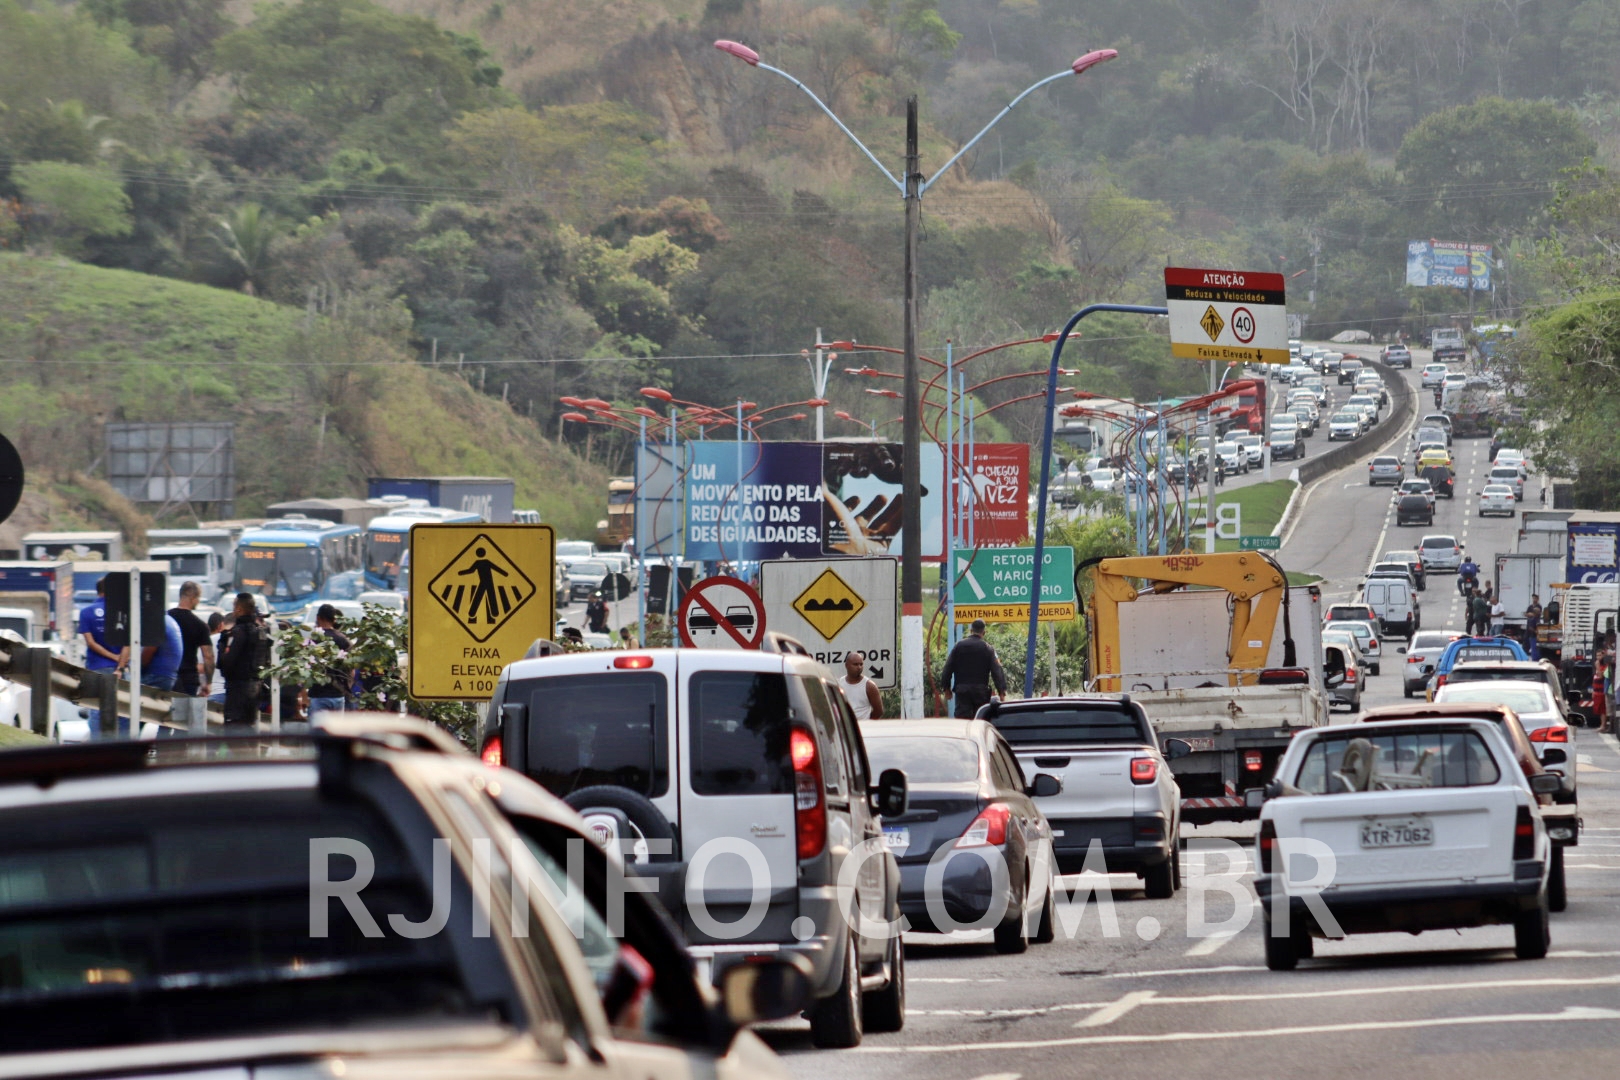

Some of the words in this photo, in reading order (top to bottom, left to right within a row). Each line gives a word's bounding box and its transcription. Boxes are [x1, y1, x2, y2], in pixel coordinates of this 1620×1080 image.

[1203, 273, 1245, 287] ATENÇÃO
[1185, 289, 1213, 299] Reduza
[1223, 292, 1265, 302] Velocidade
[1235, 316, 1251, 332] 40
[1198, 348, 1220, 357] Faixa
[1223, 350, 1252, 359] Elevada
[691, 464, 716, 480] UM
[985, 465, 1019, 477] CHEGOU
[996, 476, 1002, 486] A
[691, 485, 782, 501] MOVIMENTO
[786, 485, 825, 502] PELA
[987, 485, 1019, 504] VEZ
[691, 500, 765, 525] REDUÇÃO
[769, 505, 800, 522] DAS
[691, 526, 821, 543] DESIGUALDADES.
[1252, 538, 1279, 547] RETORNO
[992, 554, 1052, 566] RETORO
[993, 569, 1043, 581] MARIC
[993, 586, 1028, 597] CABO
[1036, 585, 1062, 596] RIO
[955, 609, 1000, 619] MANTENHA
[1003, 608, 1014, 617] SE
[1016, 607, 1023, 617] À
[1026, 607, 1071, 617] EQUERDA
[463, 648, 501, 659] FAIXA
[451, 664, 503, 676] ELEVAD
[453, 680, 463, 691] A
[468, 680, 493, 691] 100
[1361, 828, 1431, 845] KTR-7062
